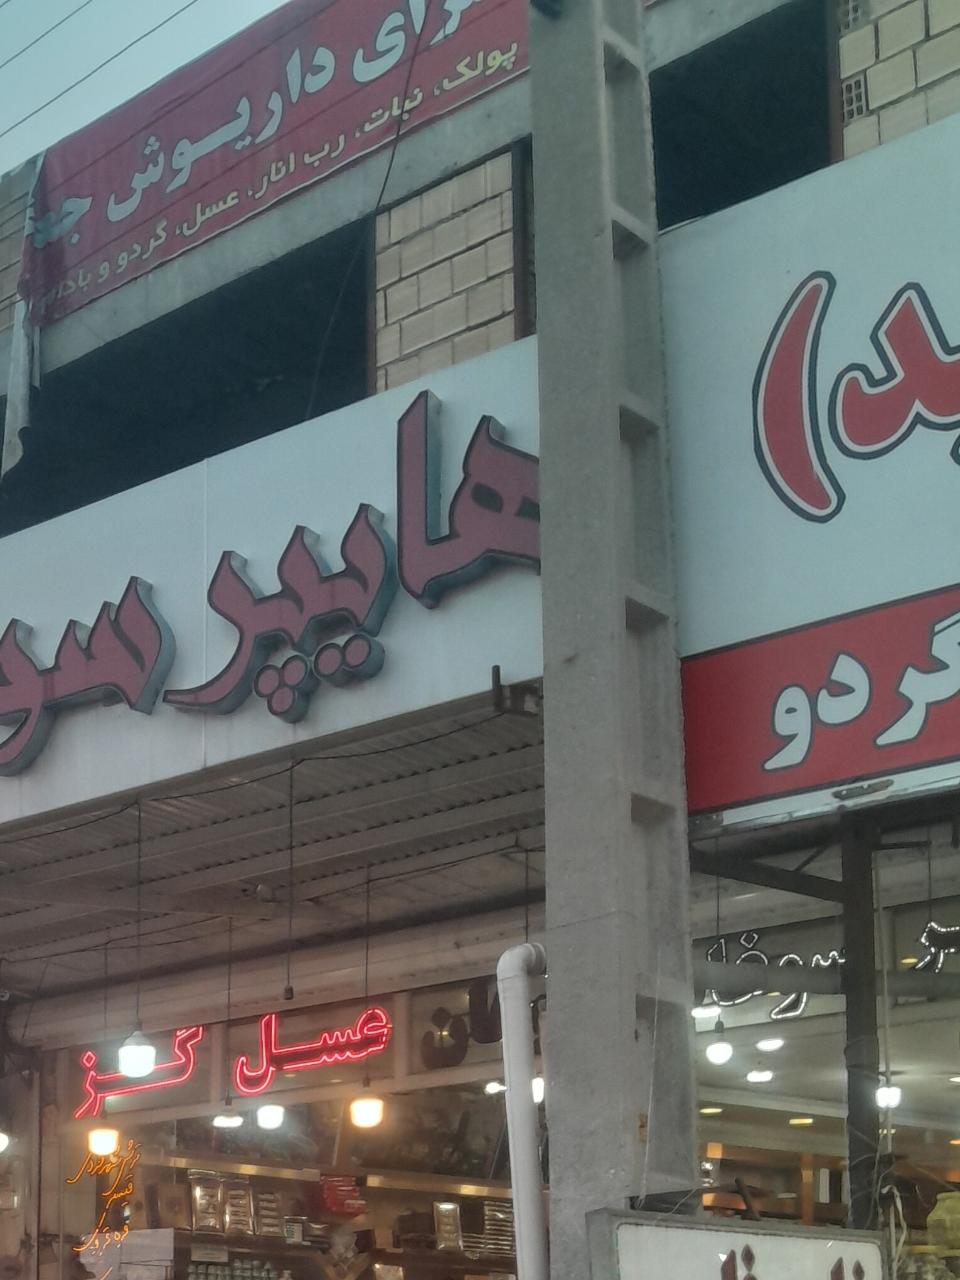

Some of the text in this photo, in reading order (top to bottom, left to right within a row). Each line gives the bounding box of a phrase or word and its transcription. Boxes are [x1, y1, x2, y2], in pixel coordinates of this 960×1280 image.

[105, 46, 336, 223] داریوش
[303, 134, 345, 168] رب
[97, 260, 111, 283] و
[163, 388, 540, 725] هایپر
[73, 1025, 204, 1119] گز
[234, 1006, 389, 1097] عسل
